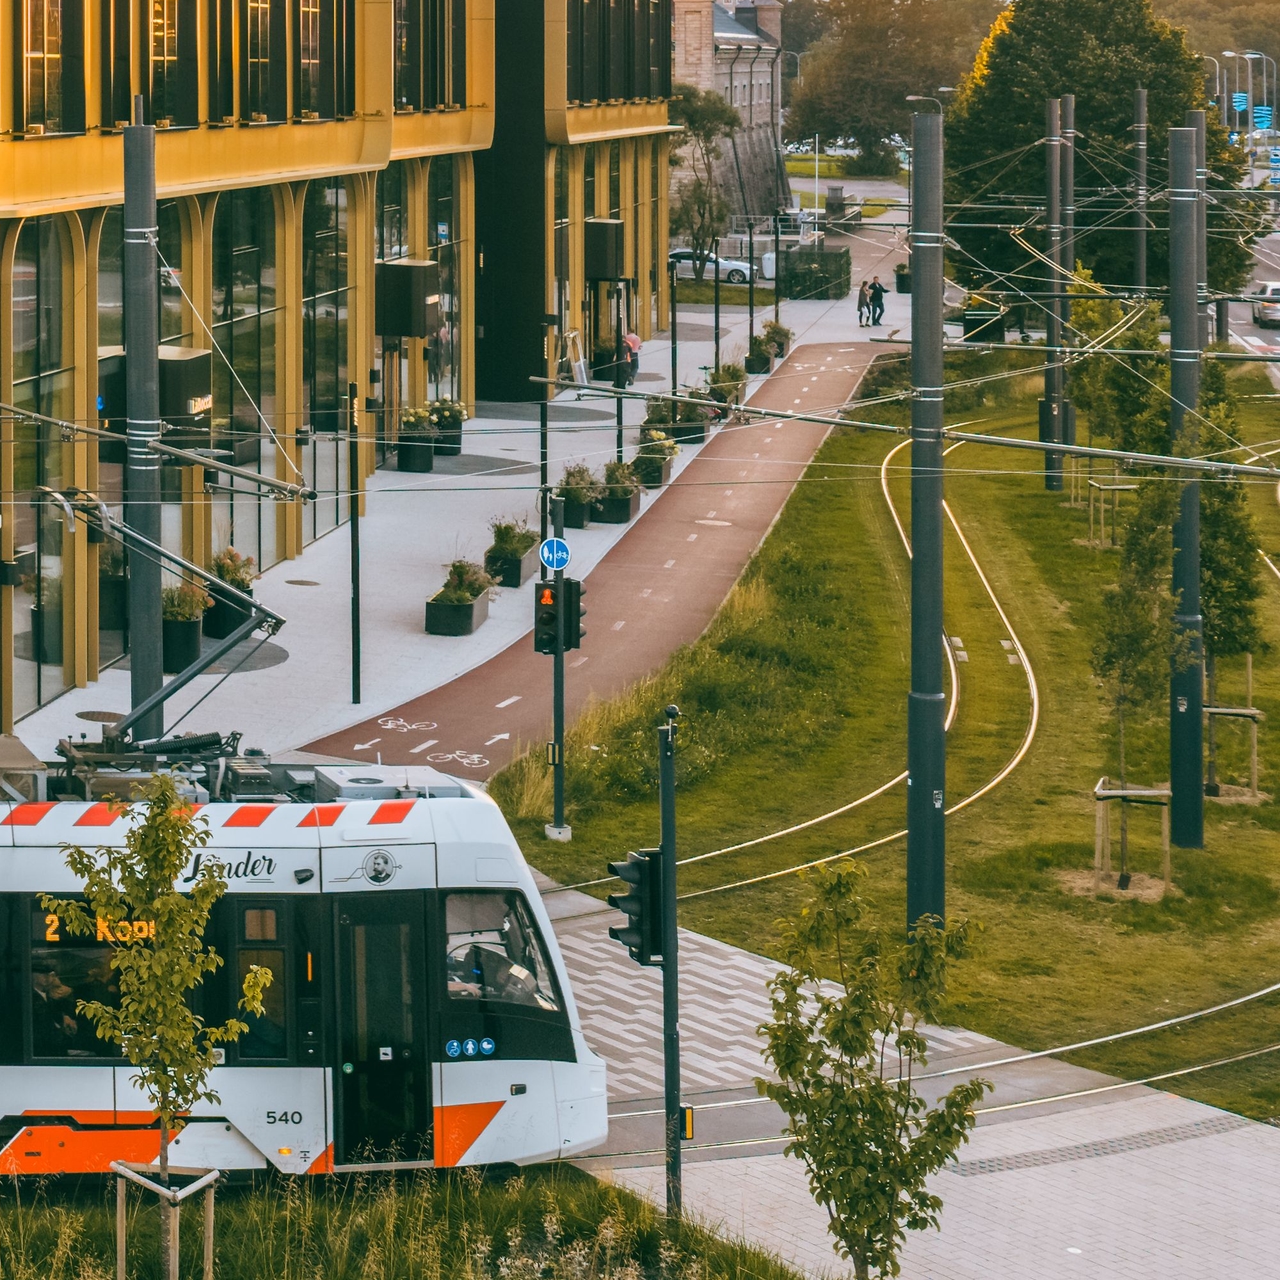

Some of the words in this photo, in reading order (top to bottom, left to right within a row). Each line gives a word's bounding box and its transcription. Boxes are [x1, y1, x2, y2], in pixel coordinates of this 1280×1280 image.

[183, 850, 277, 883] Lnder
[45, 913, 60, 942] 2
[266, 1110, 303, 1125] 540
